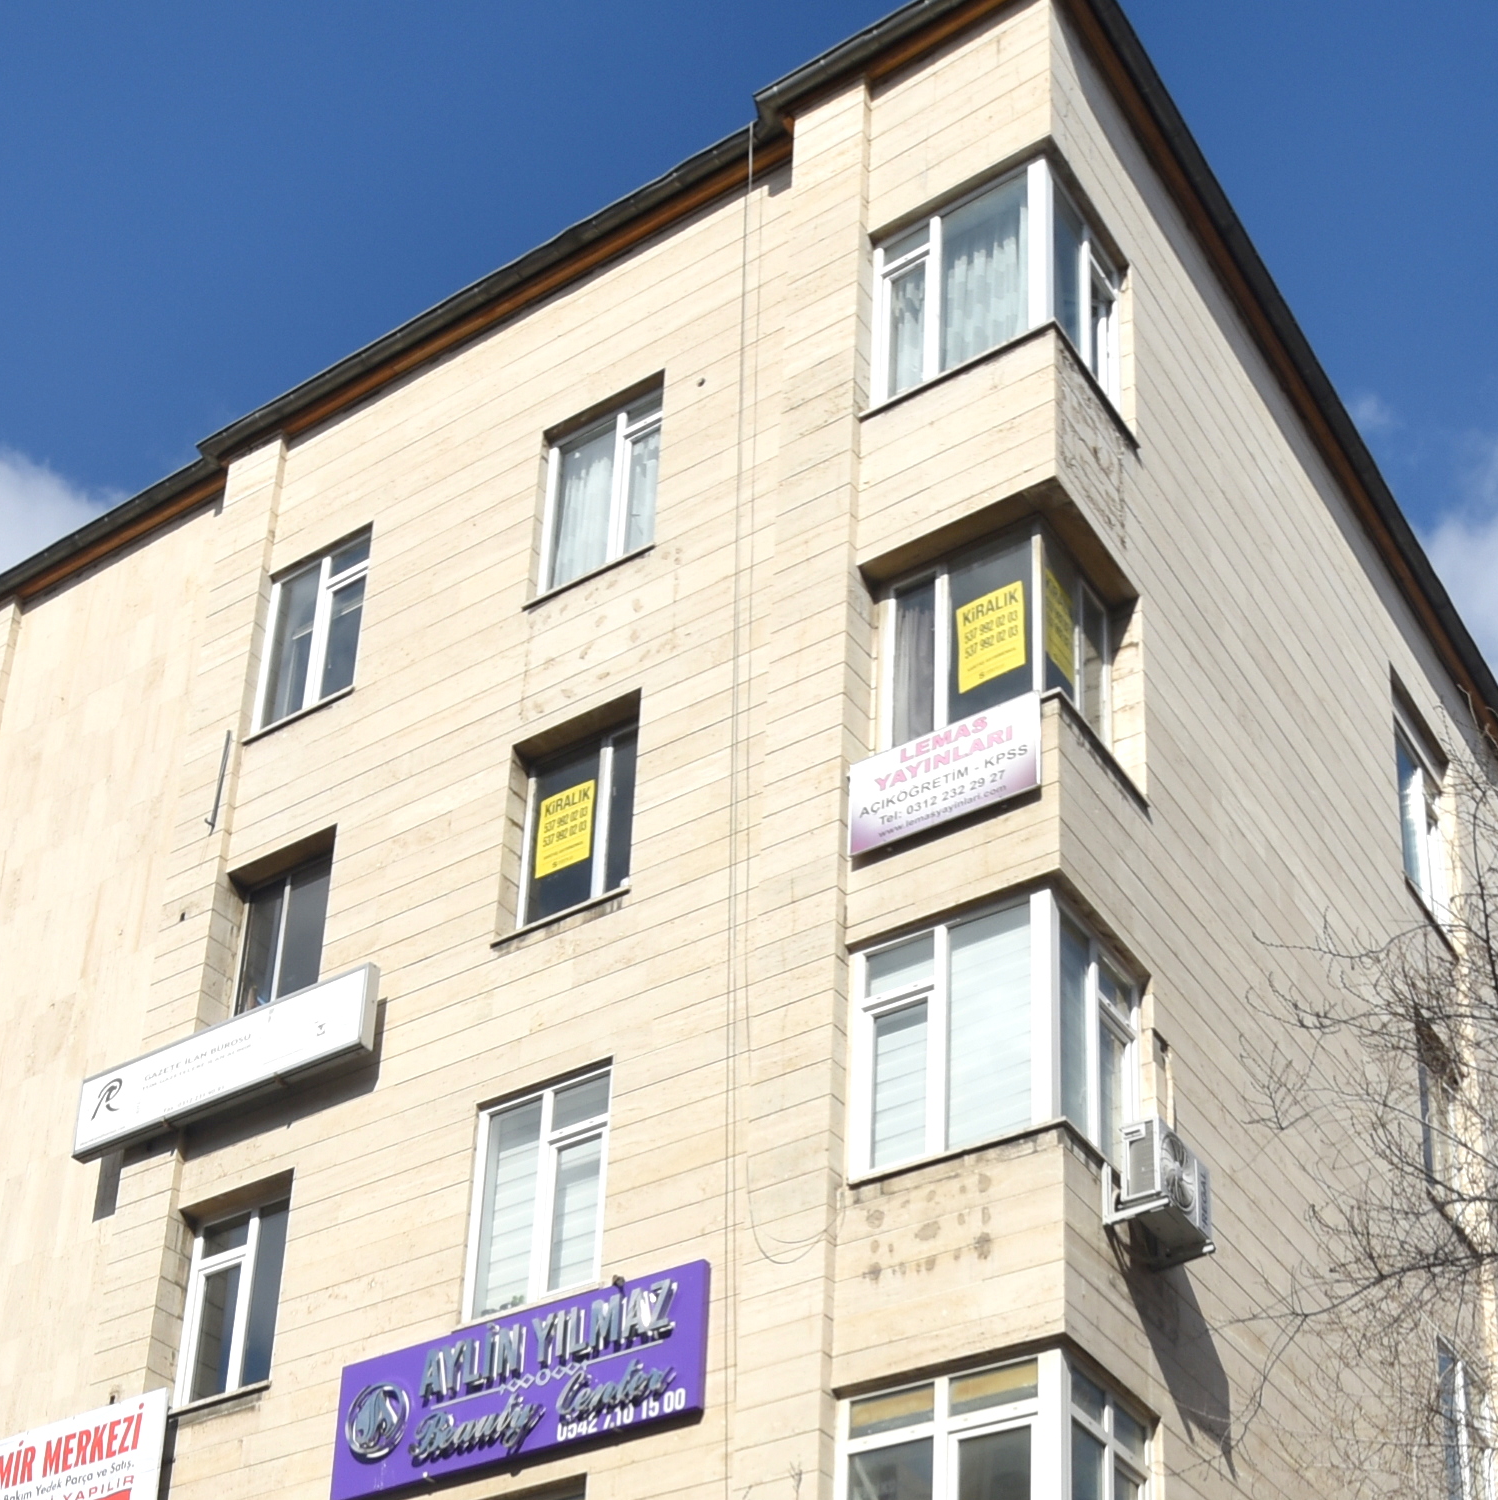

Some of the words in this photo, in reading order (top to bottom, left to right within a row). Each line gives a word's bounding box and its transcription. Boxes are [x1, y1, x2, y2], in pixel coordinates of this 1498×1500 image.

[874, 725, 1014, 792] YAYINLARI
[900, 716, 988, 764] LEMAS
[984, 744, 1028, 769] KPSS
[907, 795, 938, 815] 0312
[942, 784, 966, 802] 232
[969, 776, 986, 792] 29
[990, 769, 1006, 786] 27
[419, 1322, 526, 1402] AYLİN
[533, 1279, 677, 1365] YILMAZ
[409, 1395, 544, 1459] Beauty
[556, 1358, 672, 1423] Center
[42, 1402, 146, 1478] MERKEZİ
[35, 1480, 62, 1497] Yedek
[65, 1472, 93, 1487] Parça
[97, 1470, 107, 1478] ve
